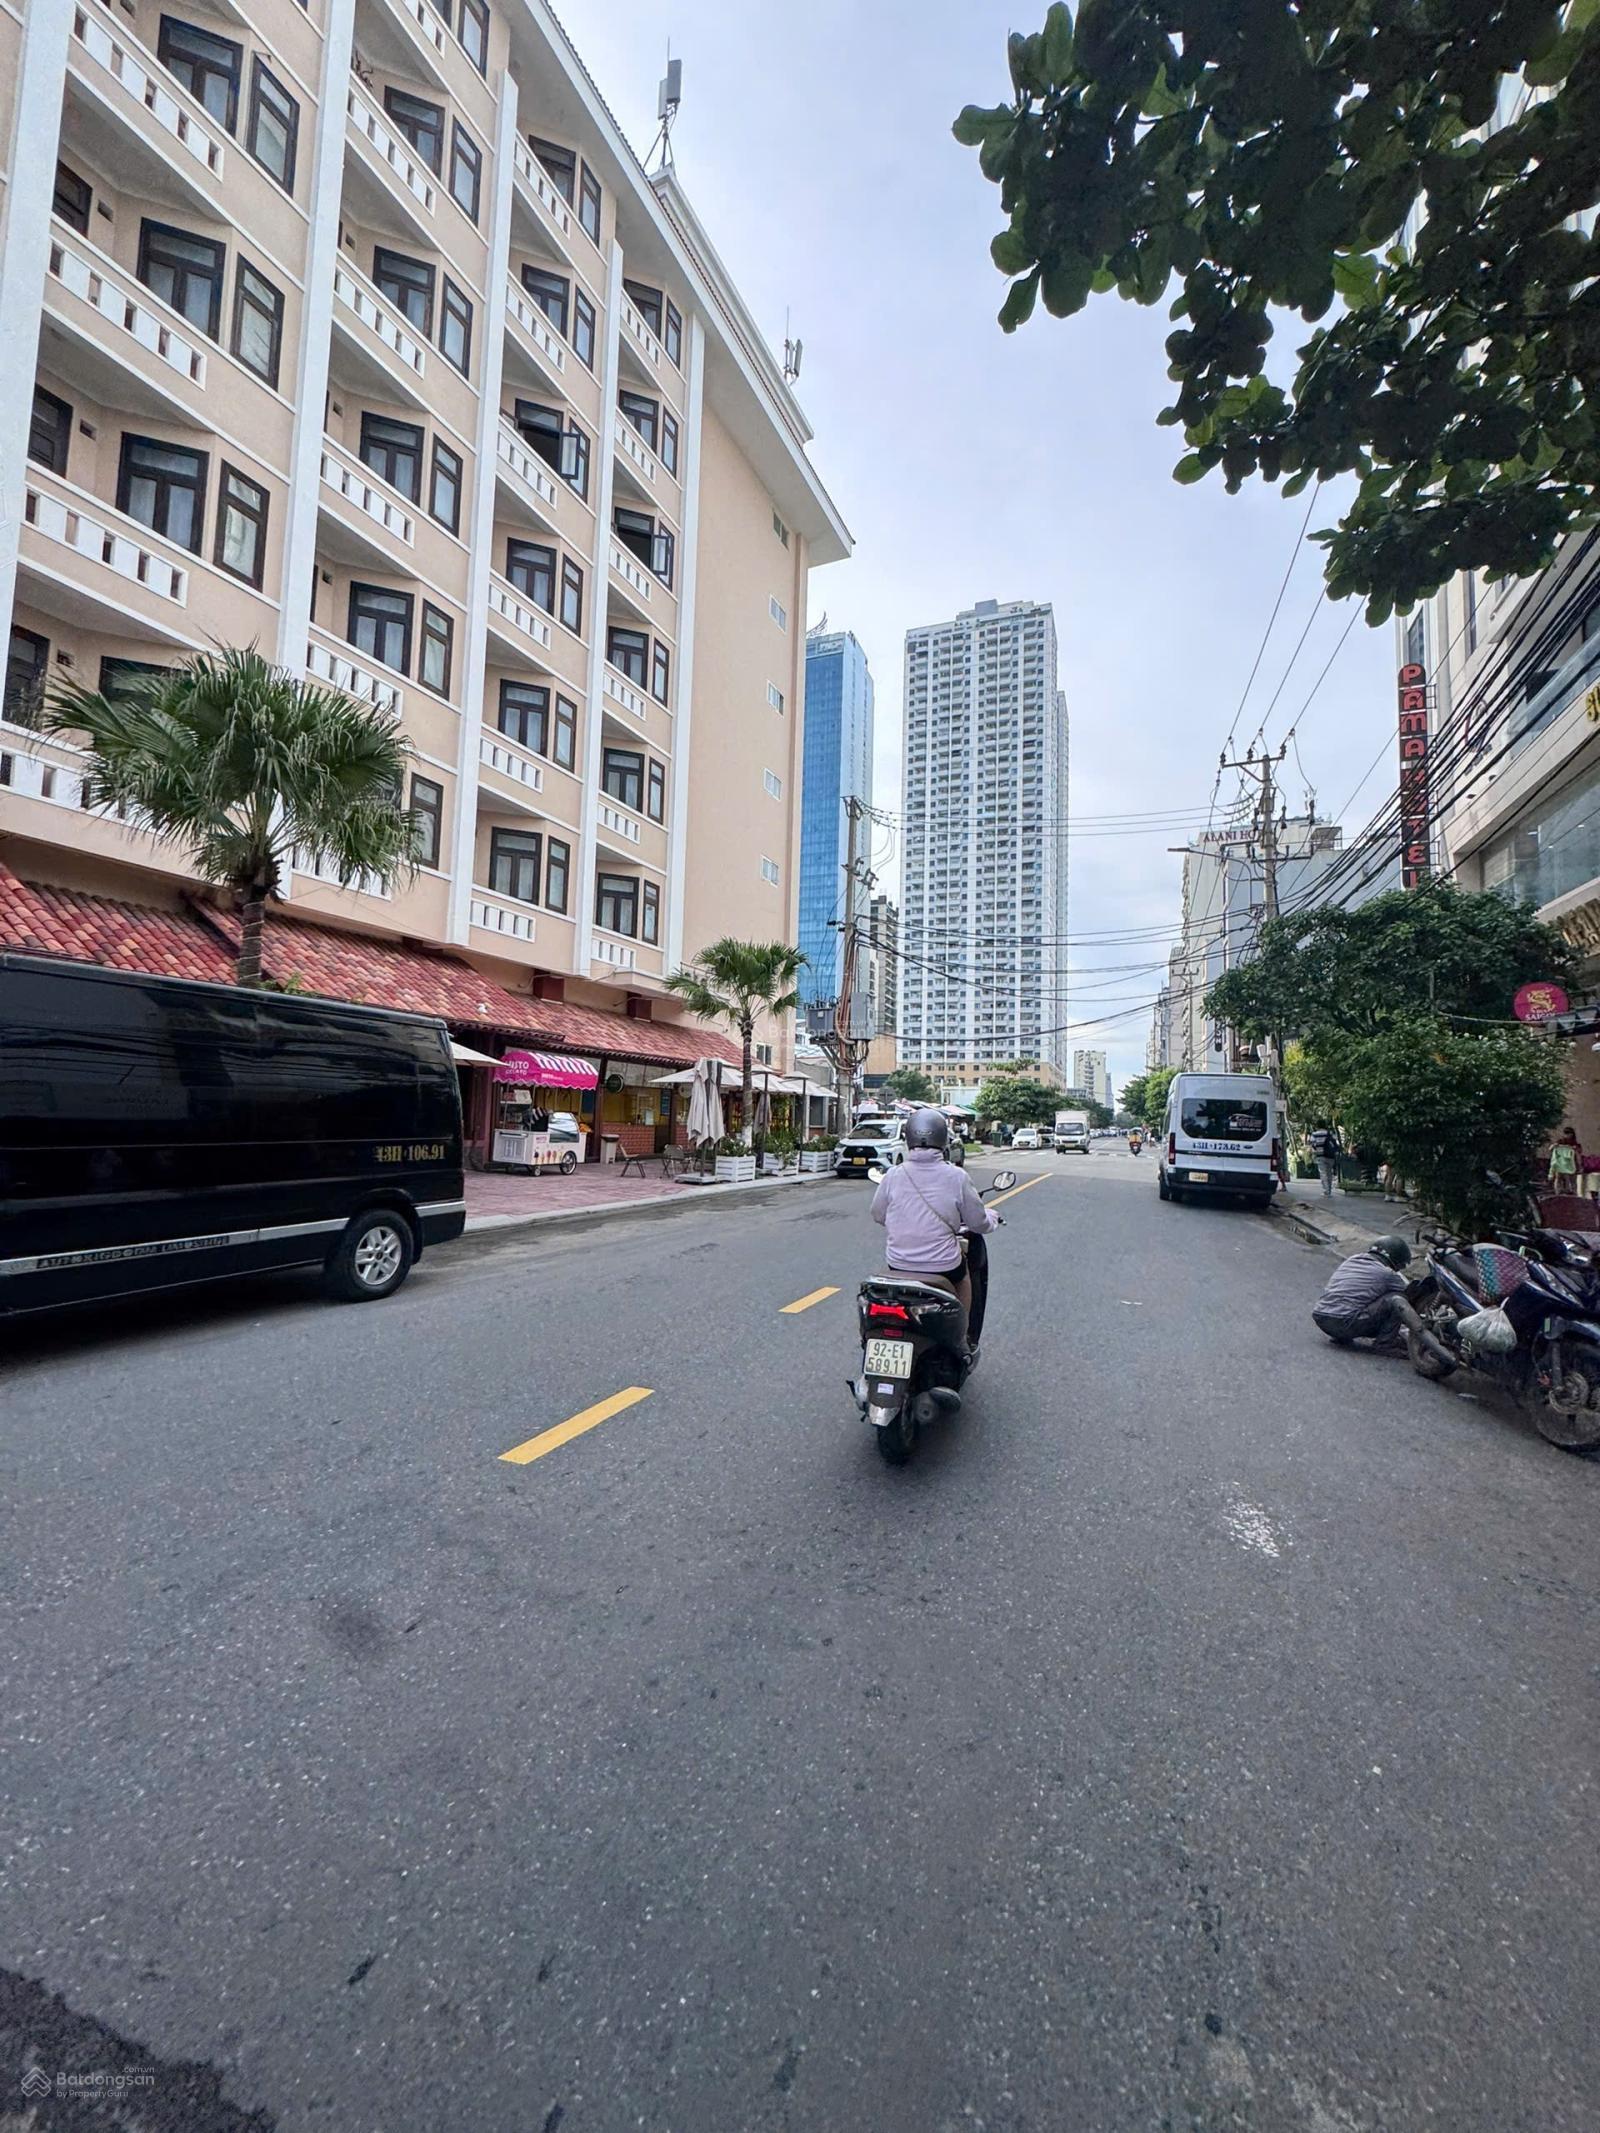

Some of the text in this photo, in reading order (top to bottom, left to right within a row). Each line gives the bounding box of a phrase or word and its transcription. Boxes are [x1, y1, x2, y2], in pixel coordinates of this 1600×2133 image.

[1401, 664, 1426, 758] PAMA
[1204, 831, 1237, 842] ALANI
[873, 1342, 905, 1359] 92-E1
[867, 1357, 907, 1376] 589.11
